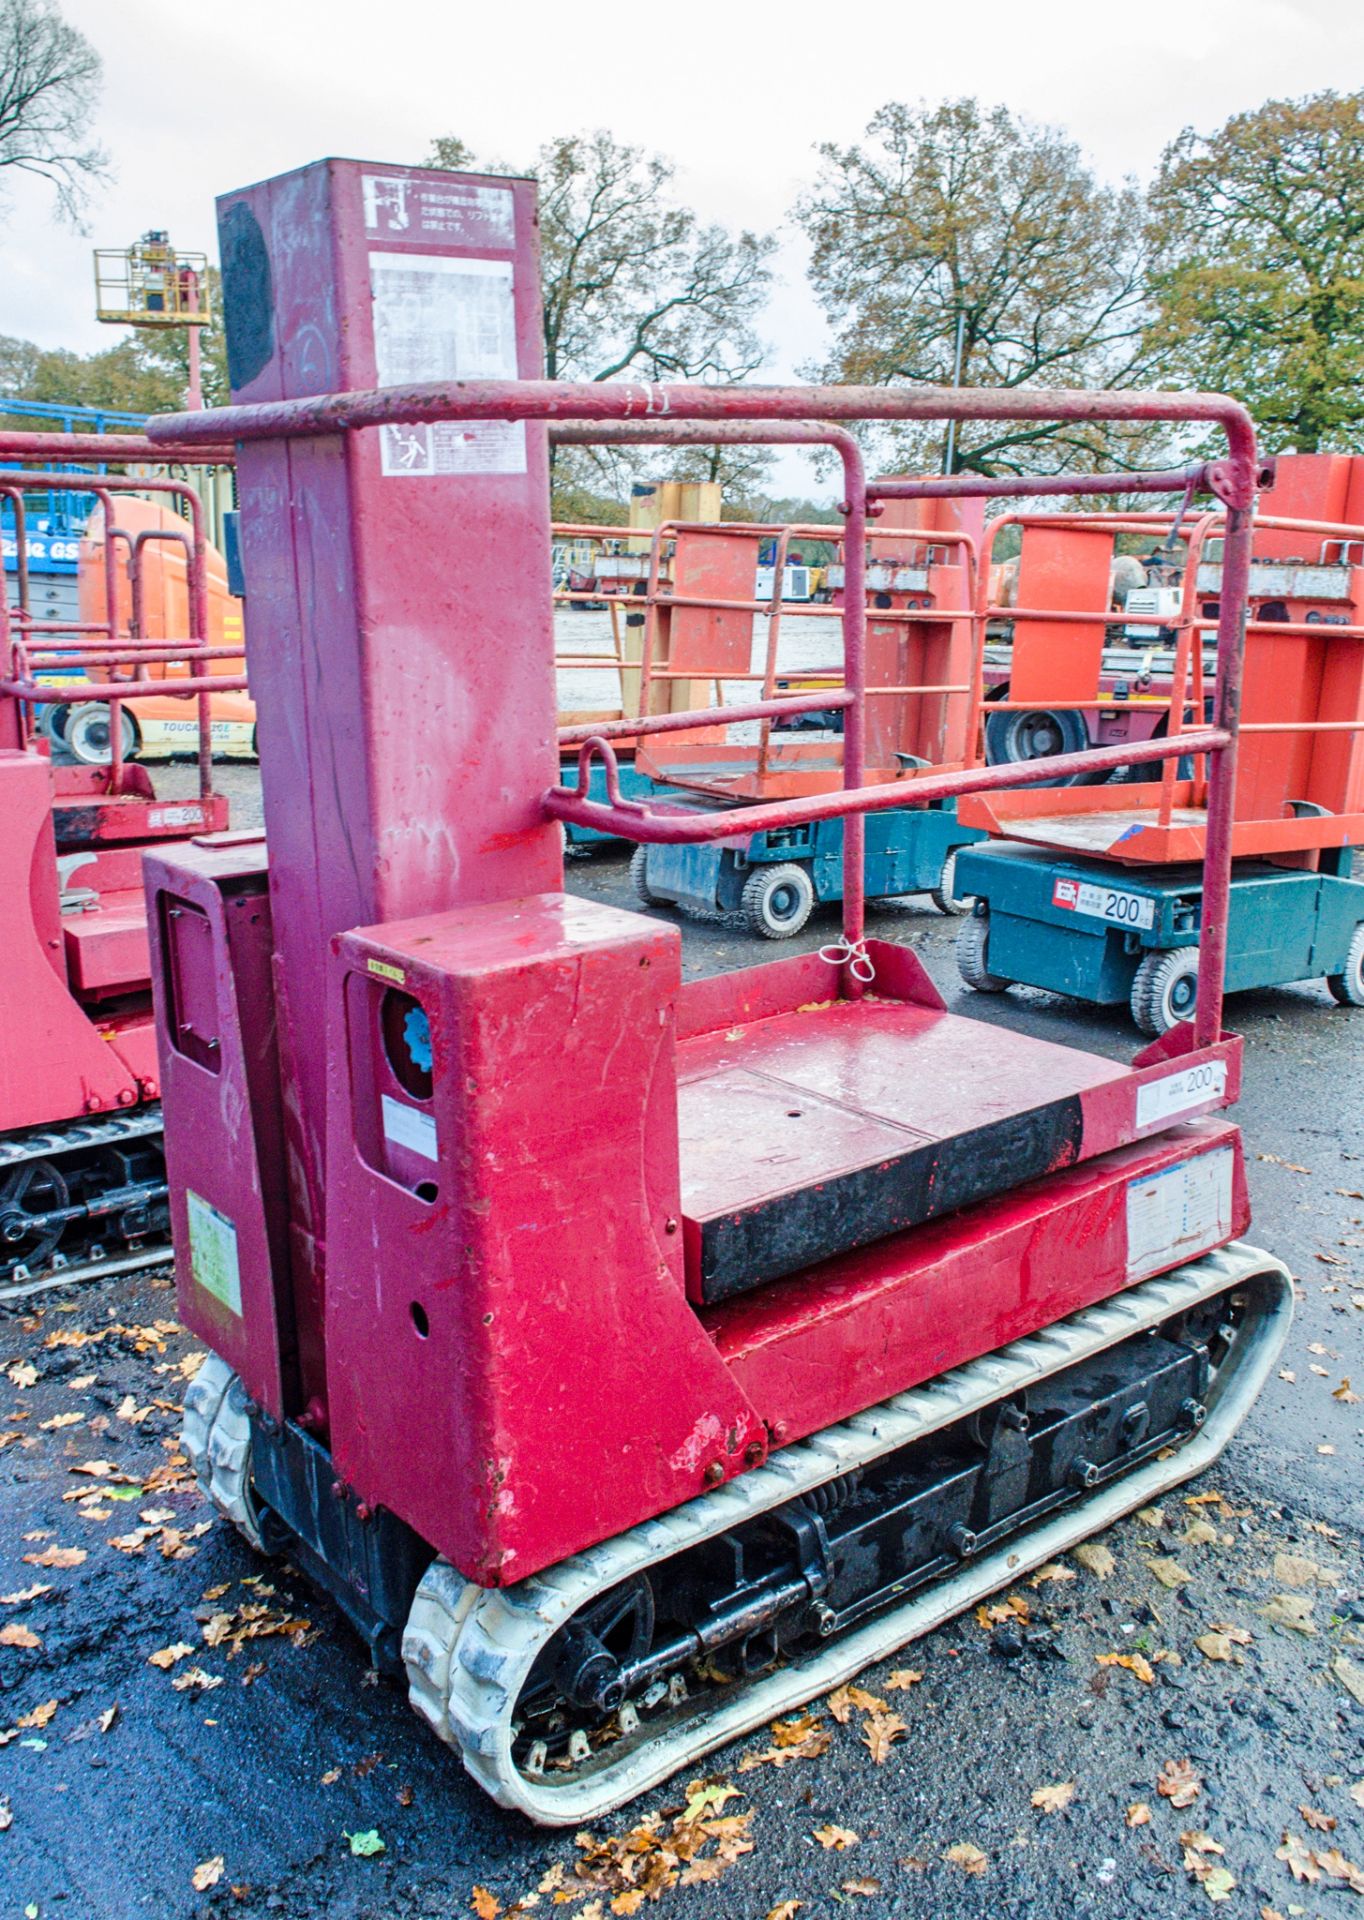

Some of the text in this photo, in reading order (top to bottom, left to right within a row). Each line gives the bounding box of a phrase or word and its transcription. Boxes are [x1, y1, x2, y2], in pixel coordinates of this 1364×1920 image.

[50, 542, 79, 560] GS
[163, 722, 200, 732] TOUCA
[1105, 893, 1140, 923] 200
[1186, 1066, 1213, 1093] 200
